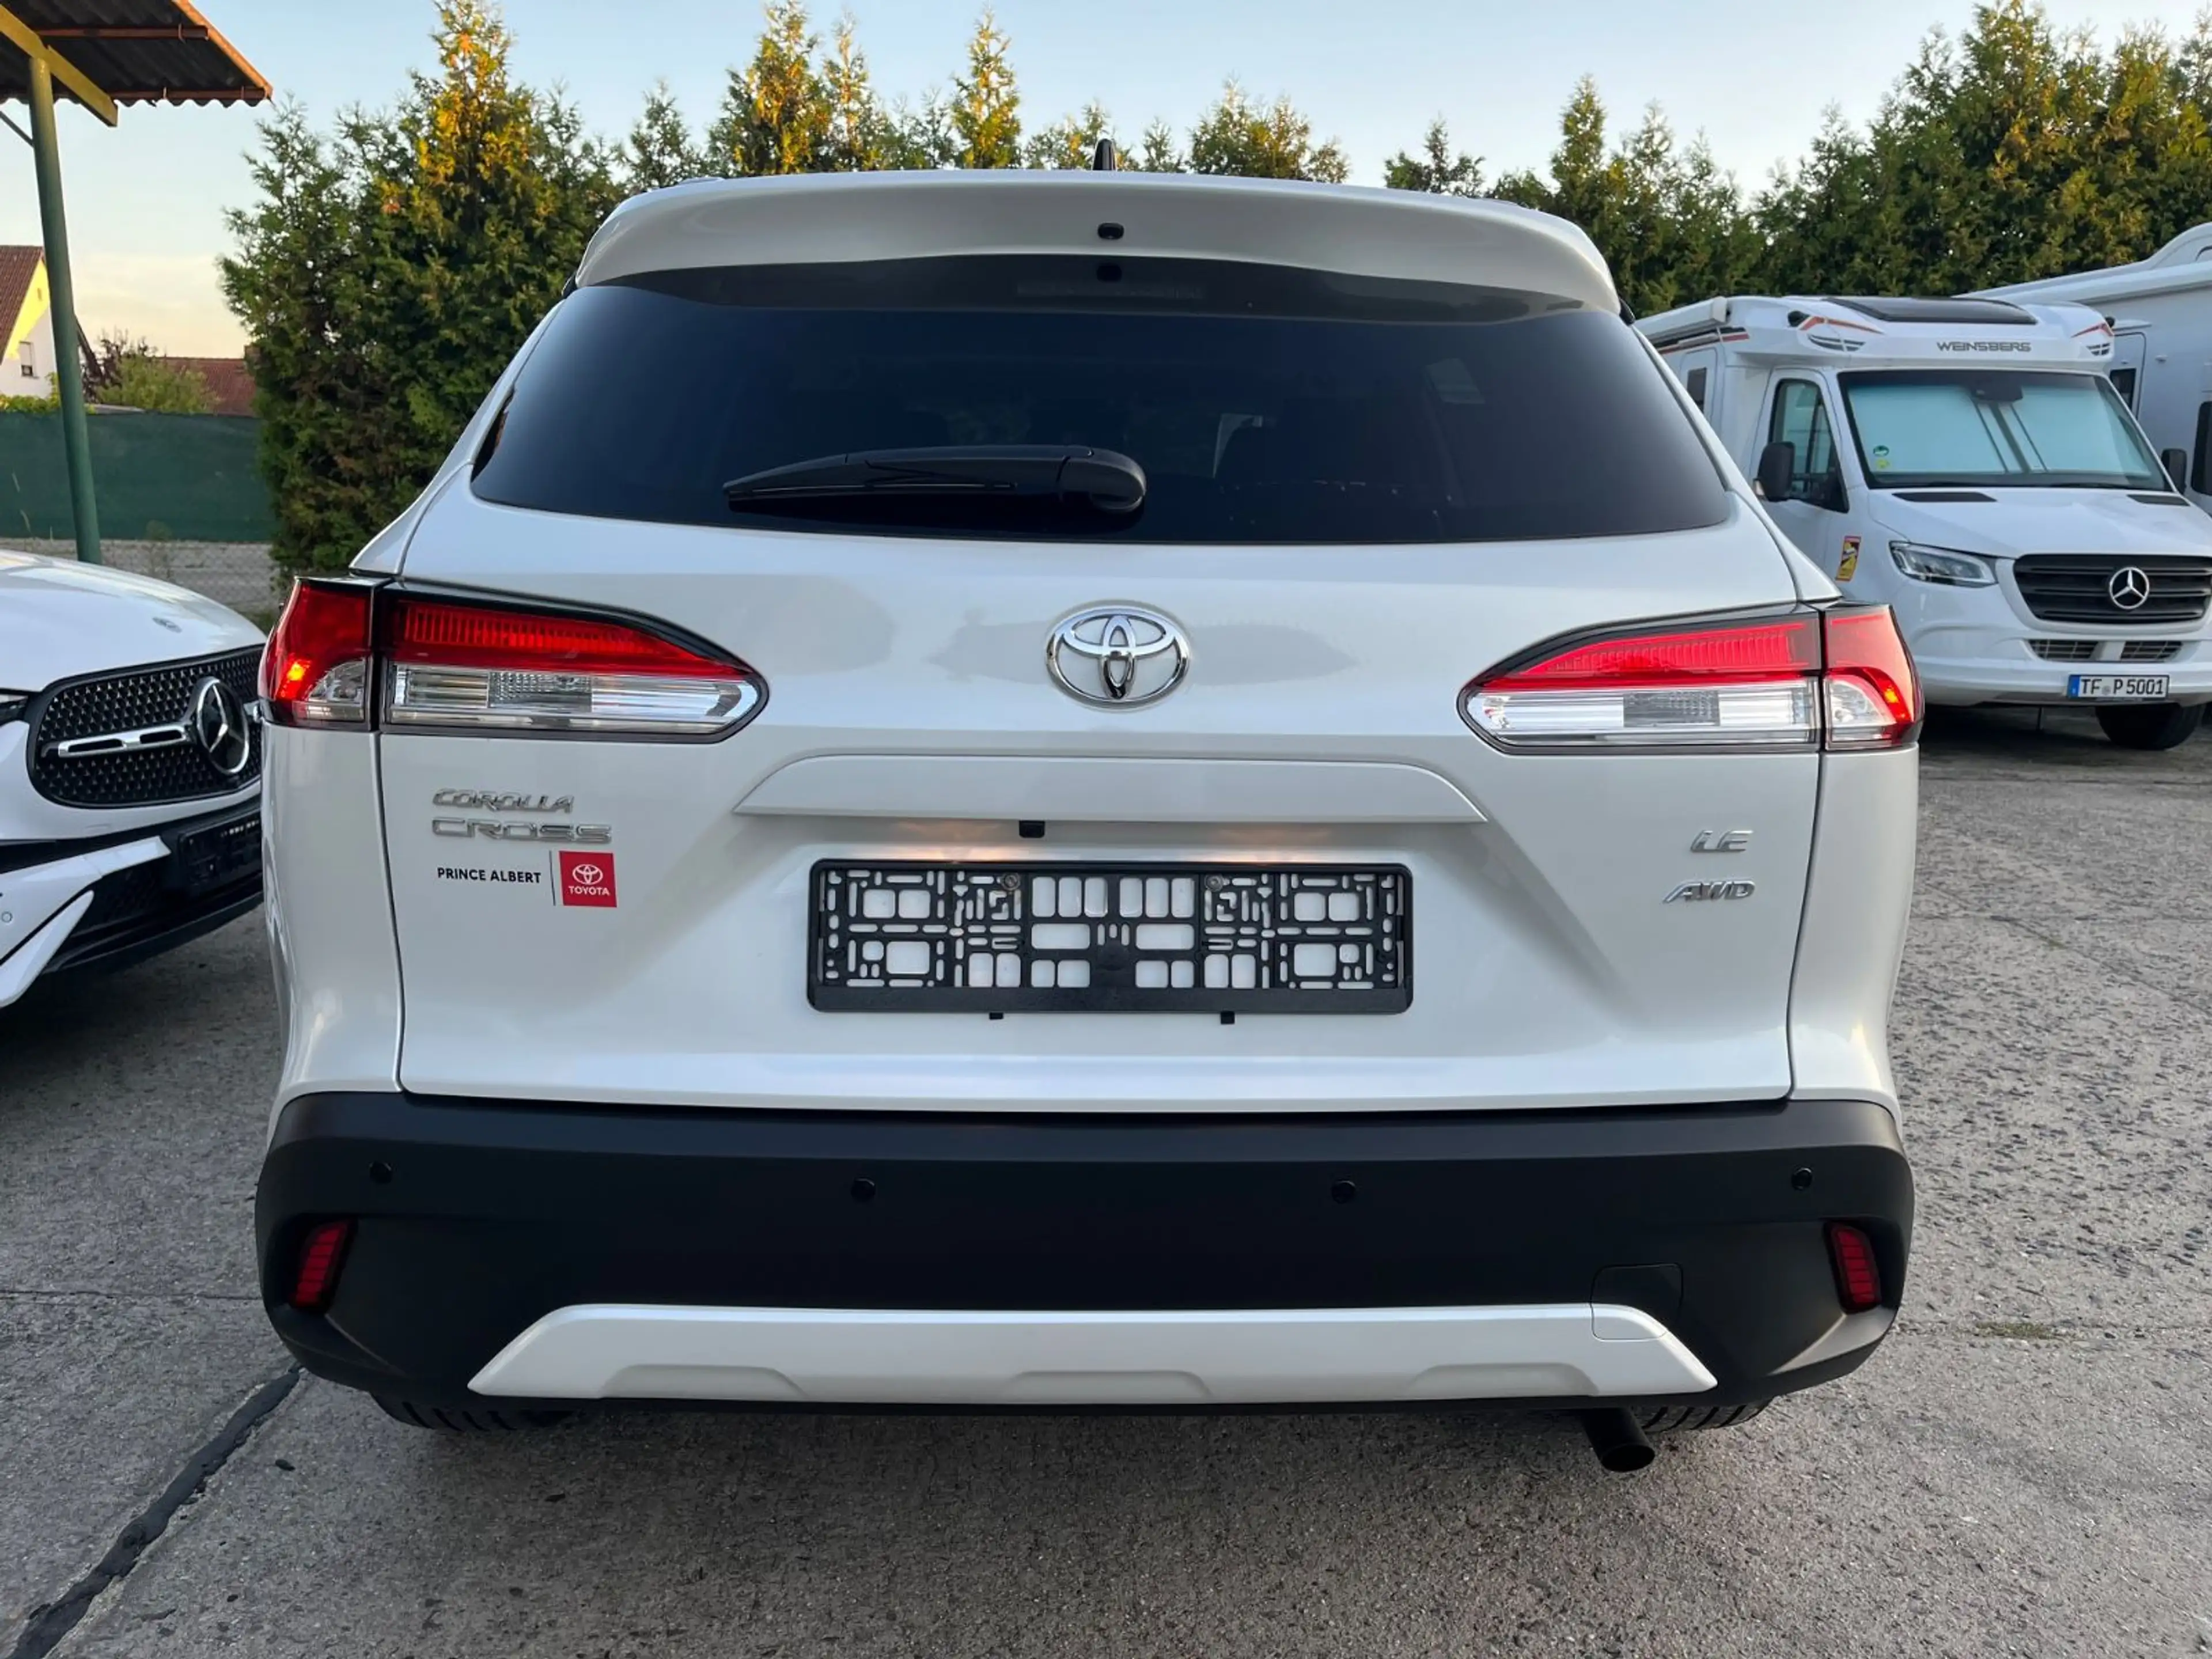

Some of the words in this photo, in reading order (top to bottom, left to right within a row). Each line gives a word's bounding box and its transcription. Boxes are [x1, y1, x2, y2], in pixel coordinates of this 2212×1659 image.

[2081, 679, 2102, 695] TF
[432, 788, 574, 814] COROLLA
[432, 817, 612, 844] CROSS
[1690, 830, 1754, 853] LE
[437, 867, 486, 882] PRINCE
[490, 870, 541, 884] ALBERT
[567, 885, 611, 896] TOYOTA
[1662, 878, 1756, 903] AWD
